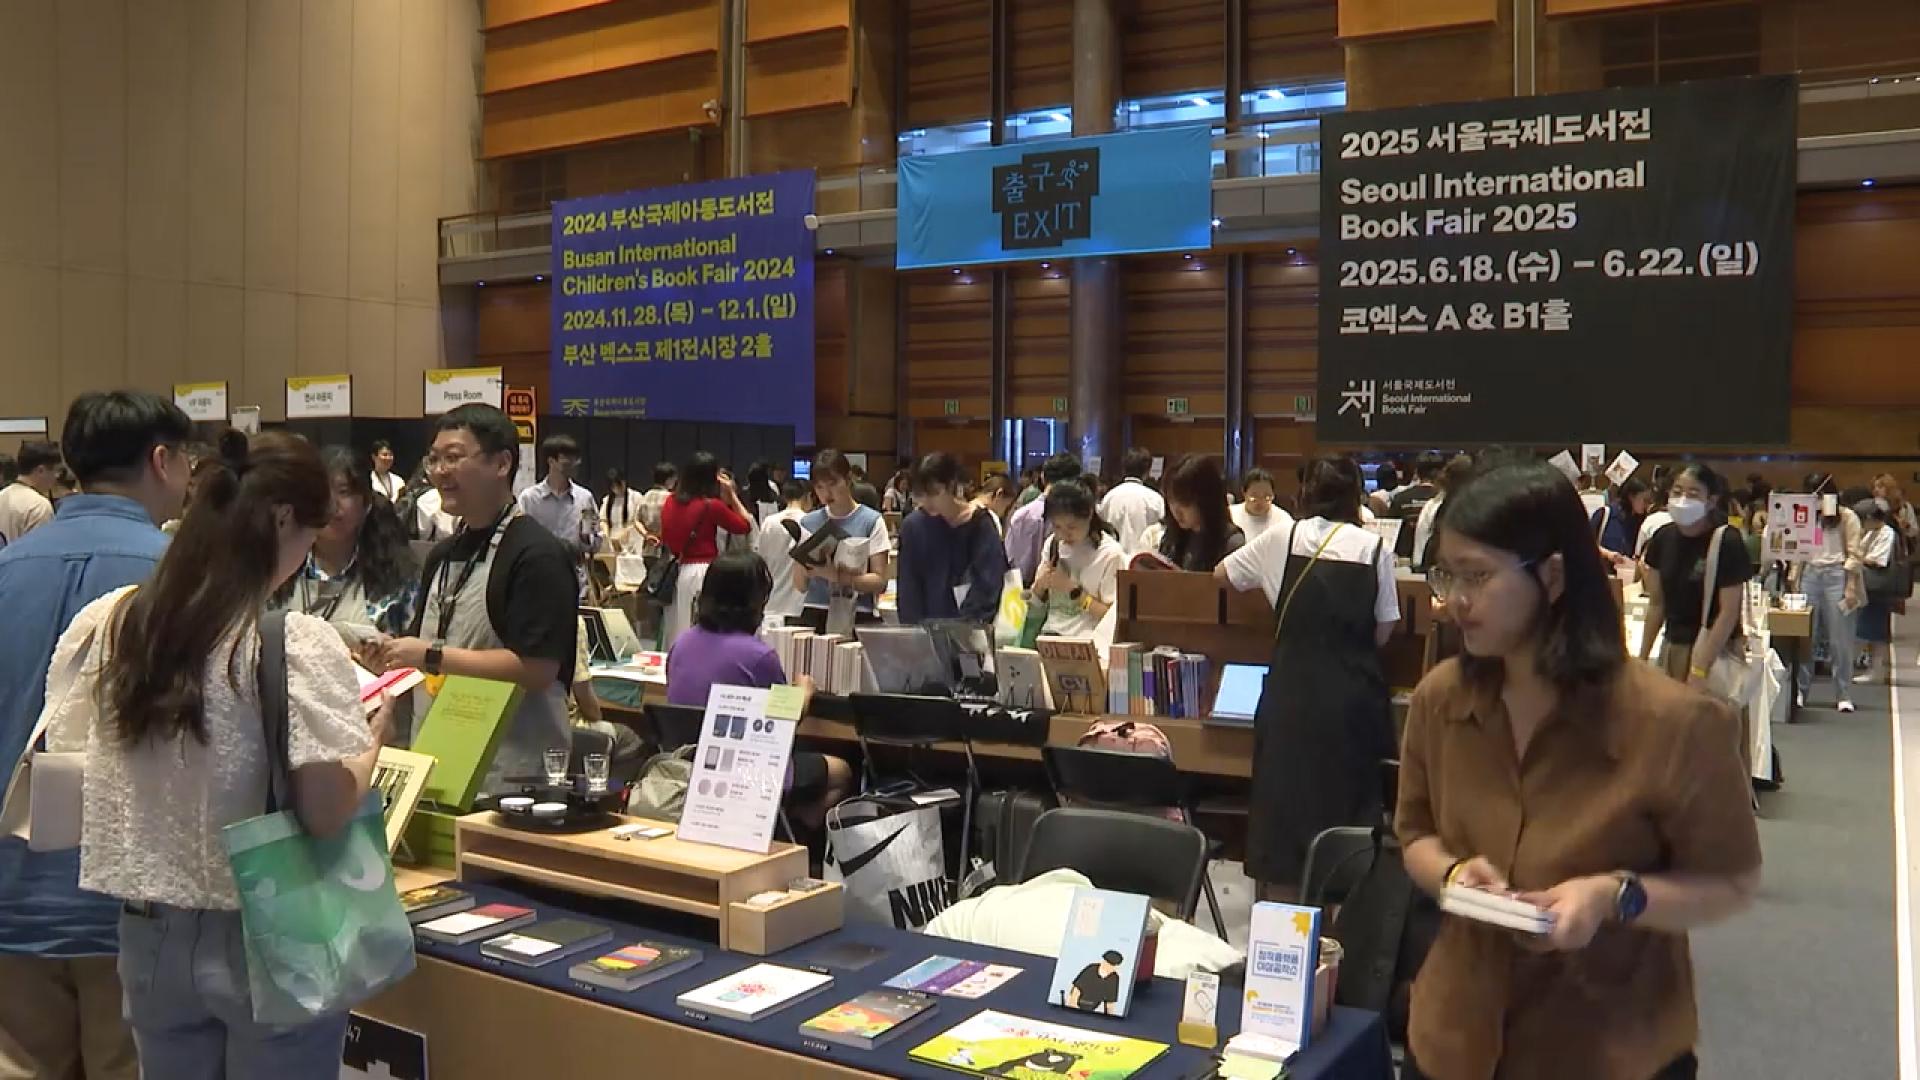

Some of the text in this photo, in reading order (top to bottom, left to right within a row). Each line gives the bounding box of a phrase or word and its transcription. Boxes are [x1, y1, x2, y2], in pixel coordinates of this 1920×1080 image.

[1340, 107, 1651, 159] 2025 서울국제도서전
[1340, 160, 1645, 204] Seoul International
[563, 190, 775, 236] 2024 부산국제아동도서전
[1014, 202, 1081, 239] EXIT
[1340, 202, 1577, 240] Book Fair 2025
[563, 234, 737, 269] Busan International
[1340, 248, 1561, 287] 2025.6.18.(수)
[1604, 241, 1759, 278] 6.22.(일)
[563, 256, 796, 296] Children's Book Fair 2024
[563, 299, 694, 331] 2024.11.28.(목)
[719, 293, 797, 320] 12.1.(일)
[1340, 300, 1573, 334] 코엑스 A & B1홀
[563, 333, 773, 366] 부산 벡스코 제1전시장 2홀
[443, 389, 483, 401] Press Room
[1382, 392, 1471, 403] Seoul International
[1382, 403, 1428, 415] Book Fair
